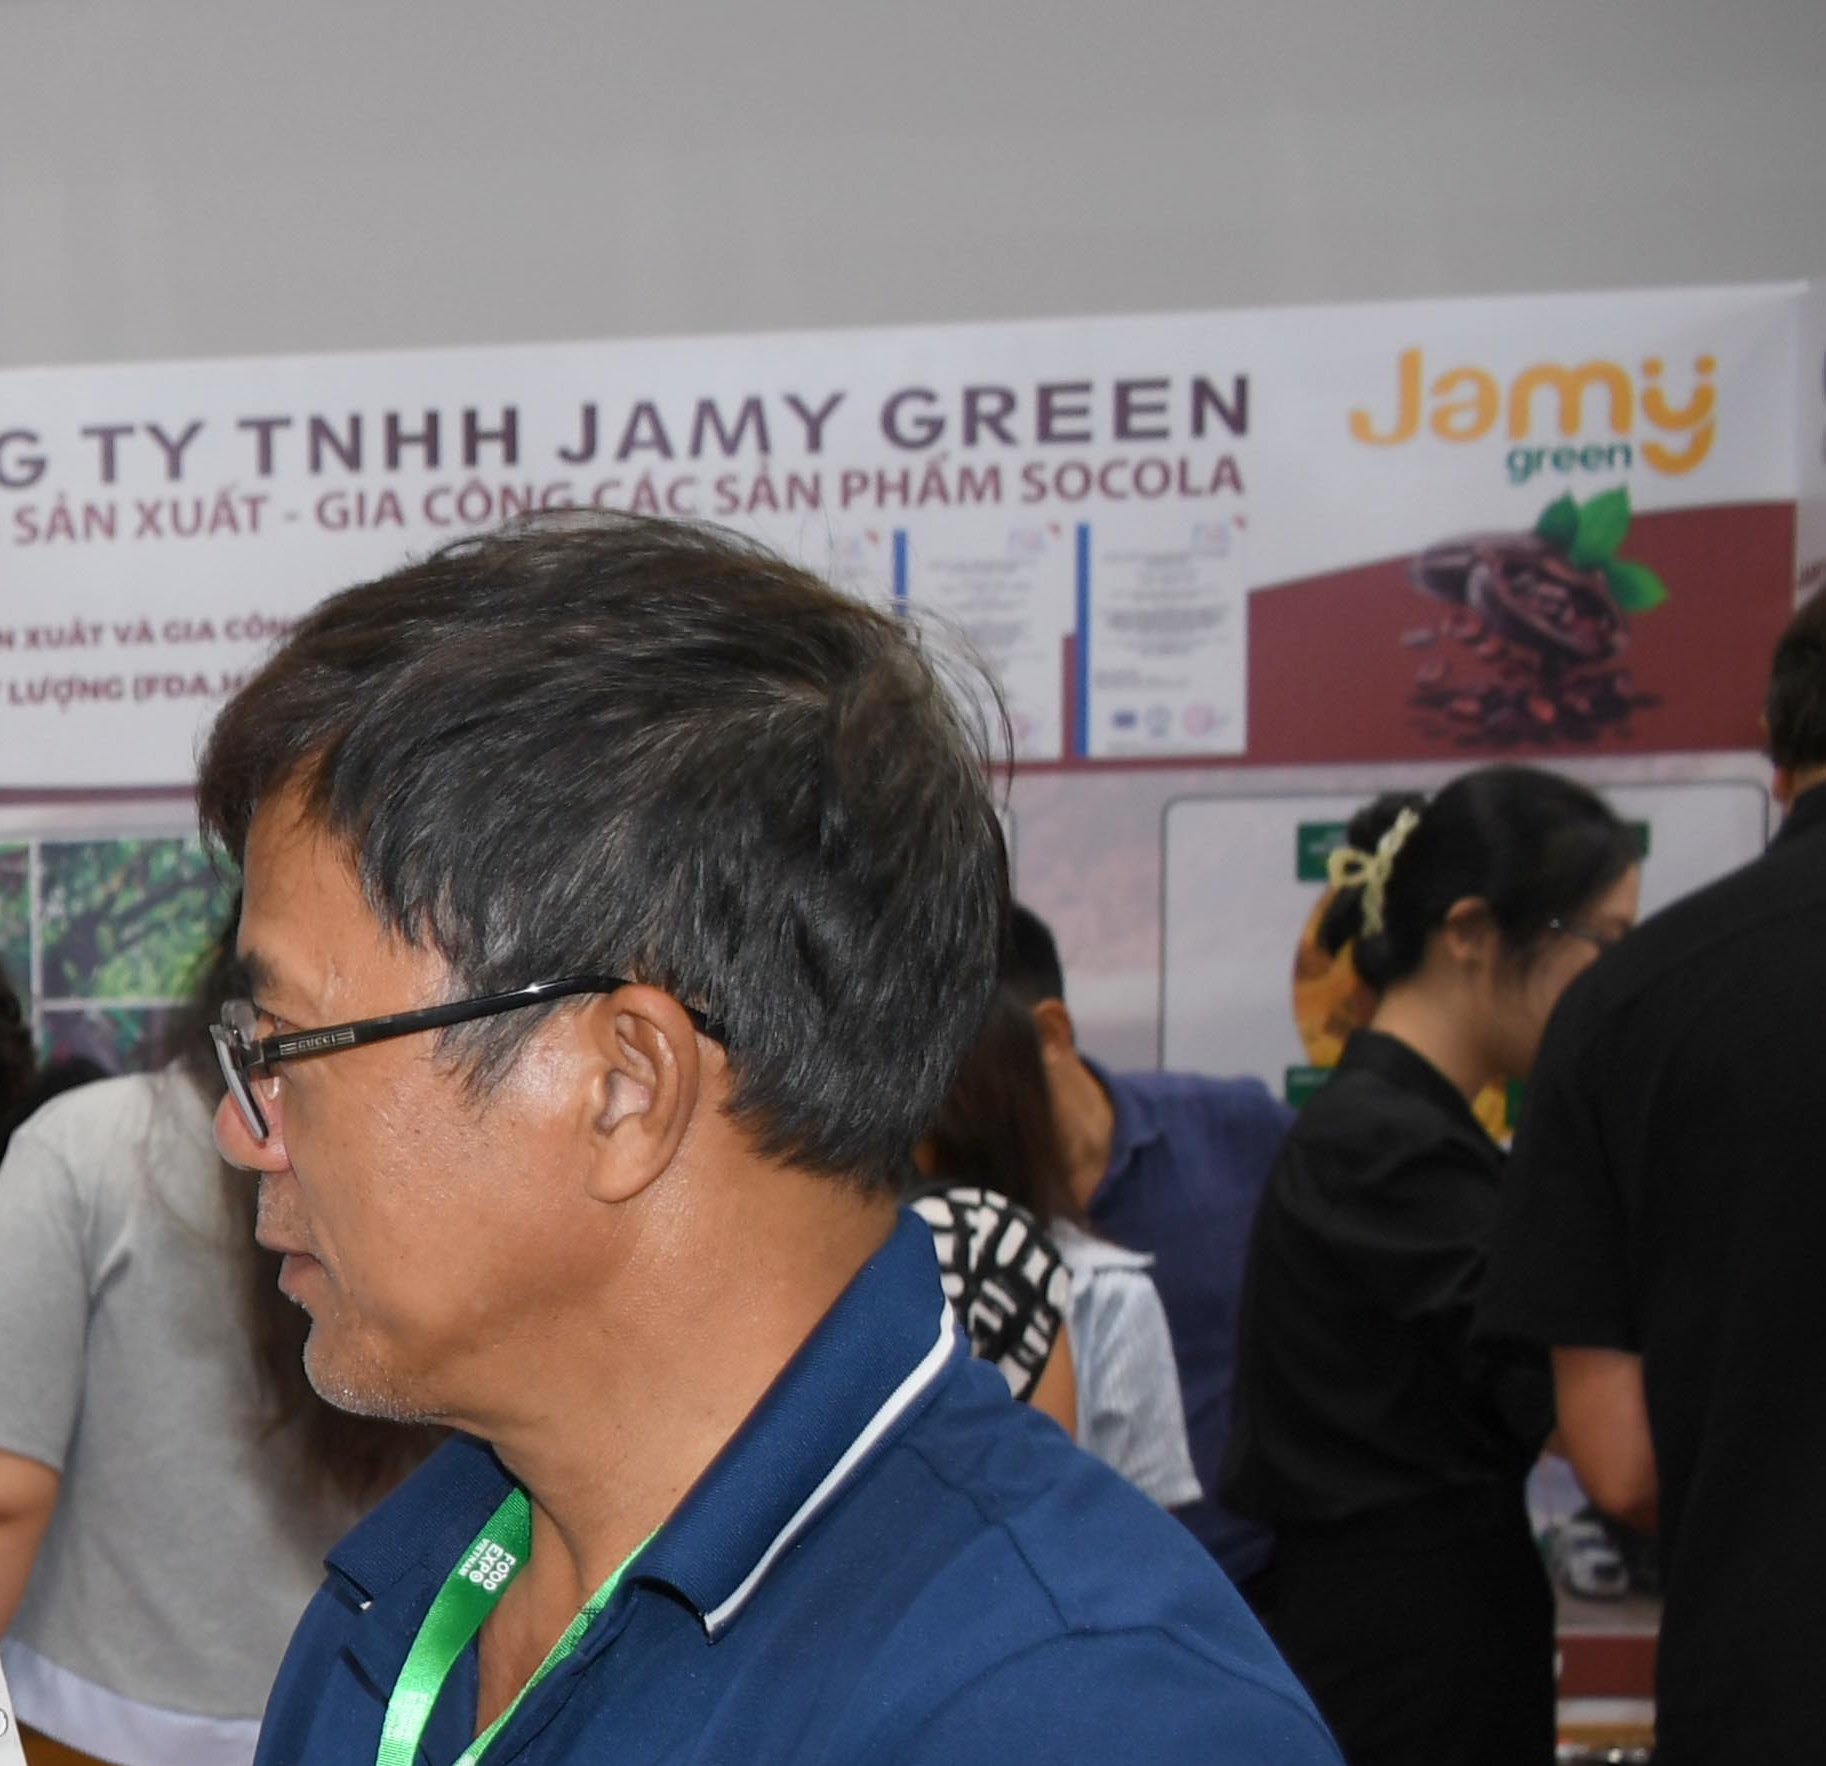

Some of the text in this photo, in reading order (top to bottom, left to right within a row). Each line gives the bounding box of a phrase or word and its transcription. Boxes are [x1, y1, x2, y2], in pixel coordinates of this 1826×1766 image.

[80, 419, 207, 485] TY
[236, 405, 520, 480] TNHH
[558, 393, 847, 465] JAMY
[880, 375, 1250, 454] GREEN
[1349, 346, 1718, 477] Jamy
[1505, 437, 1633, 485] green
[12, 490, 118, 546] SẢN
[134, 482, 268, 540] XUẤT
[316, 491, 405, 533] GIA
[591, 466, 696, 517] CÁC
[713, 460, 823, 516] SẢN
[840, 451, 1003, 511] PHẨM
[1019, 453, 1246, 505] SOCOLA
[24, 614, 103, 649] XUẤT
[112, 612, 155, 645] VÀ
[162, 617, 216, 645] GIA
[225, 610, 297, 643] CÔN
[468, 1542, 505, 1584] EXPO
[481, 1551, 518, 1592] FOOD
